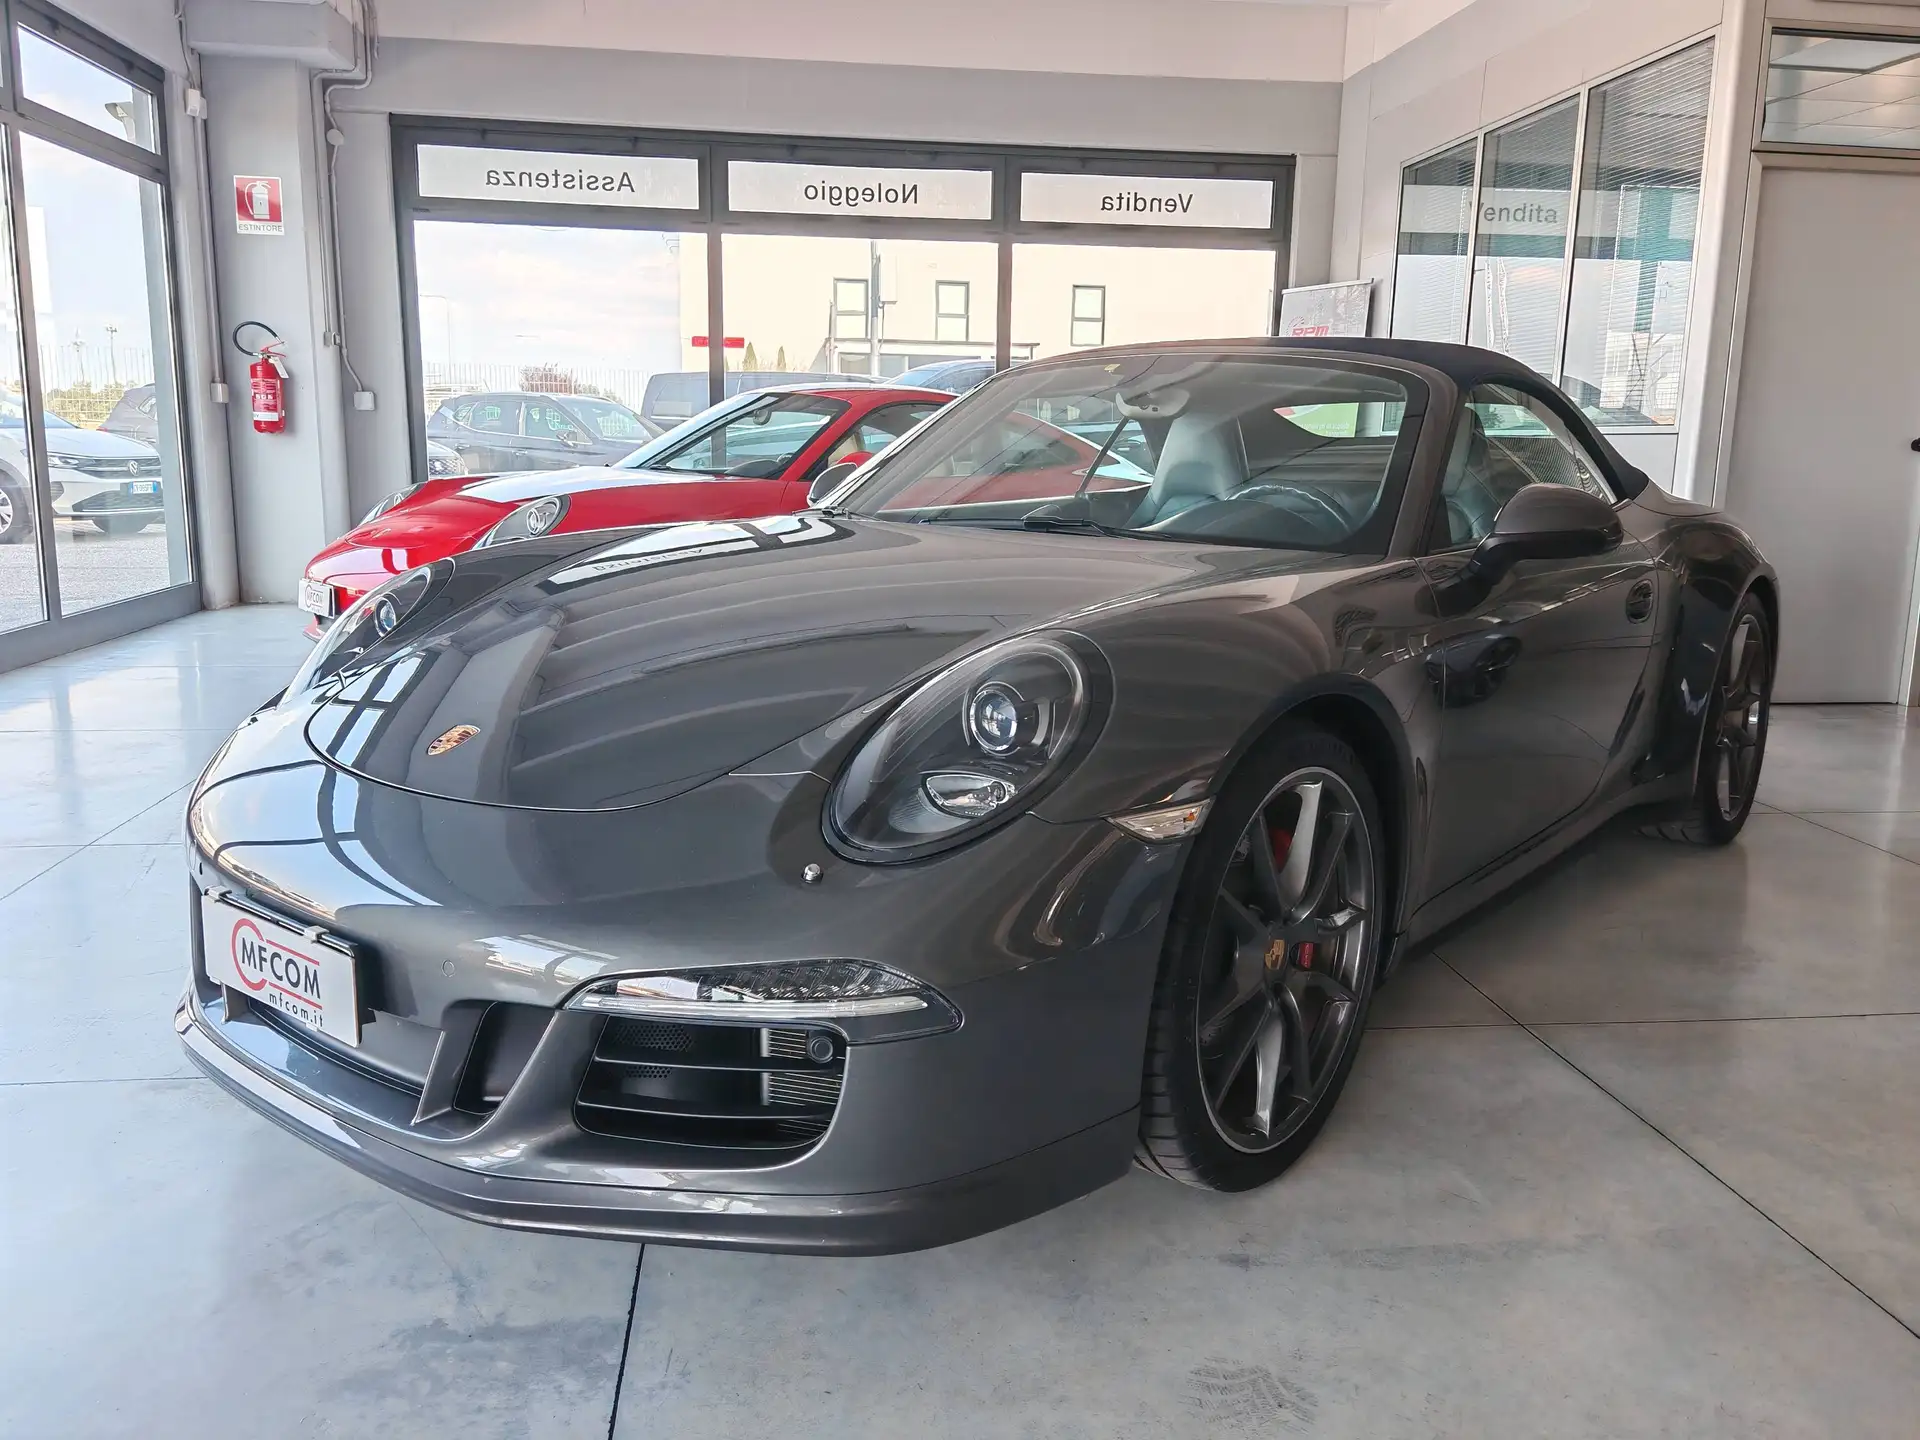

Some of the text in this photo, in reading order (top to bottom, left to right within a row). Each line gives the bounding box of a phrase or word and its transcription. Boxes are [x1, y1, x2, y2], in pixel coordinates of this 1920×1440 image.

[238, 223, 283, 232] ESTINTORE
[241, 937, 322, 999] MFCOM
[269, 992, 324, 1028] mfcom.it
